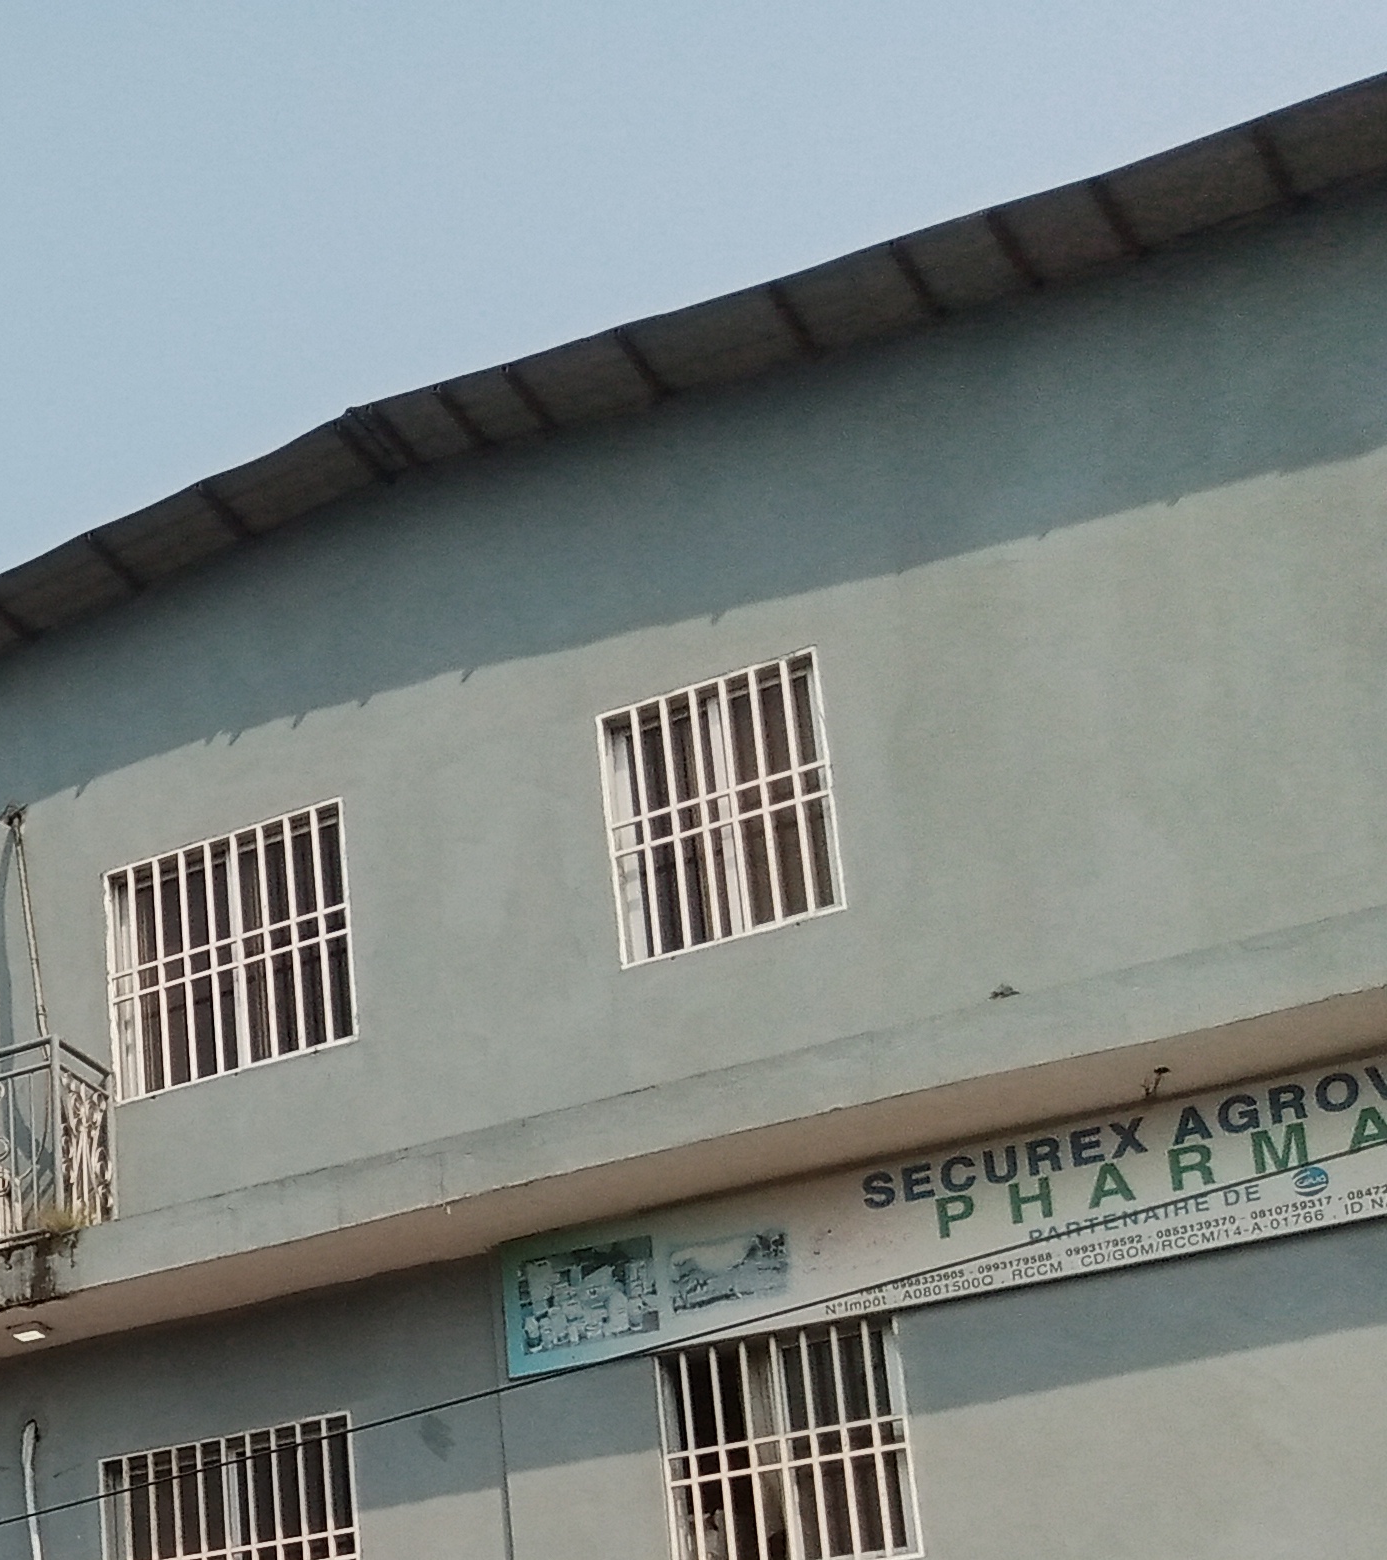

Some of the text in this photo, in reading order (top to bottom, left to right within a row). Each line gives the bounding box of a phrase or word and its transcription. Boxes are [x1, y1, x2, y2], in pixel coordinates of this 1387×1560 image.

[862, 1116, 1148, 1209] SECUREX
[1028, 1184, 1261, 1244] PARTENAIRE DE
[1012, 1260, 1063, 1282] RCCM
